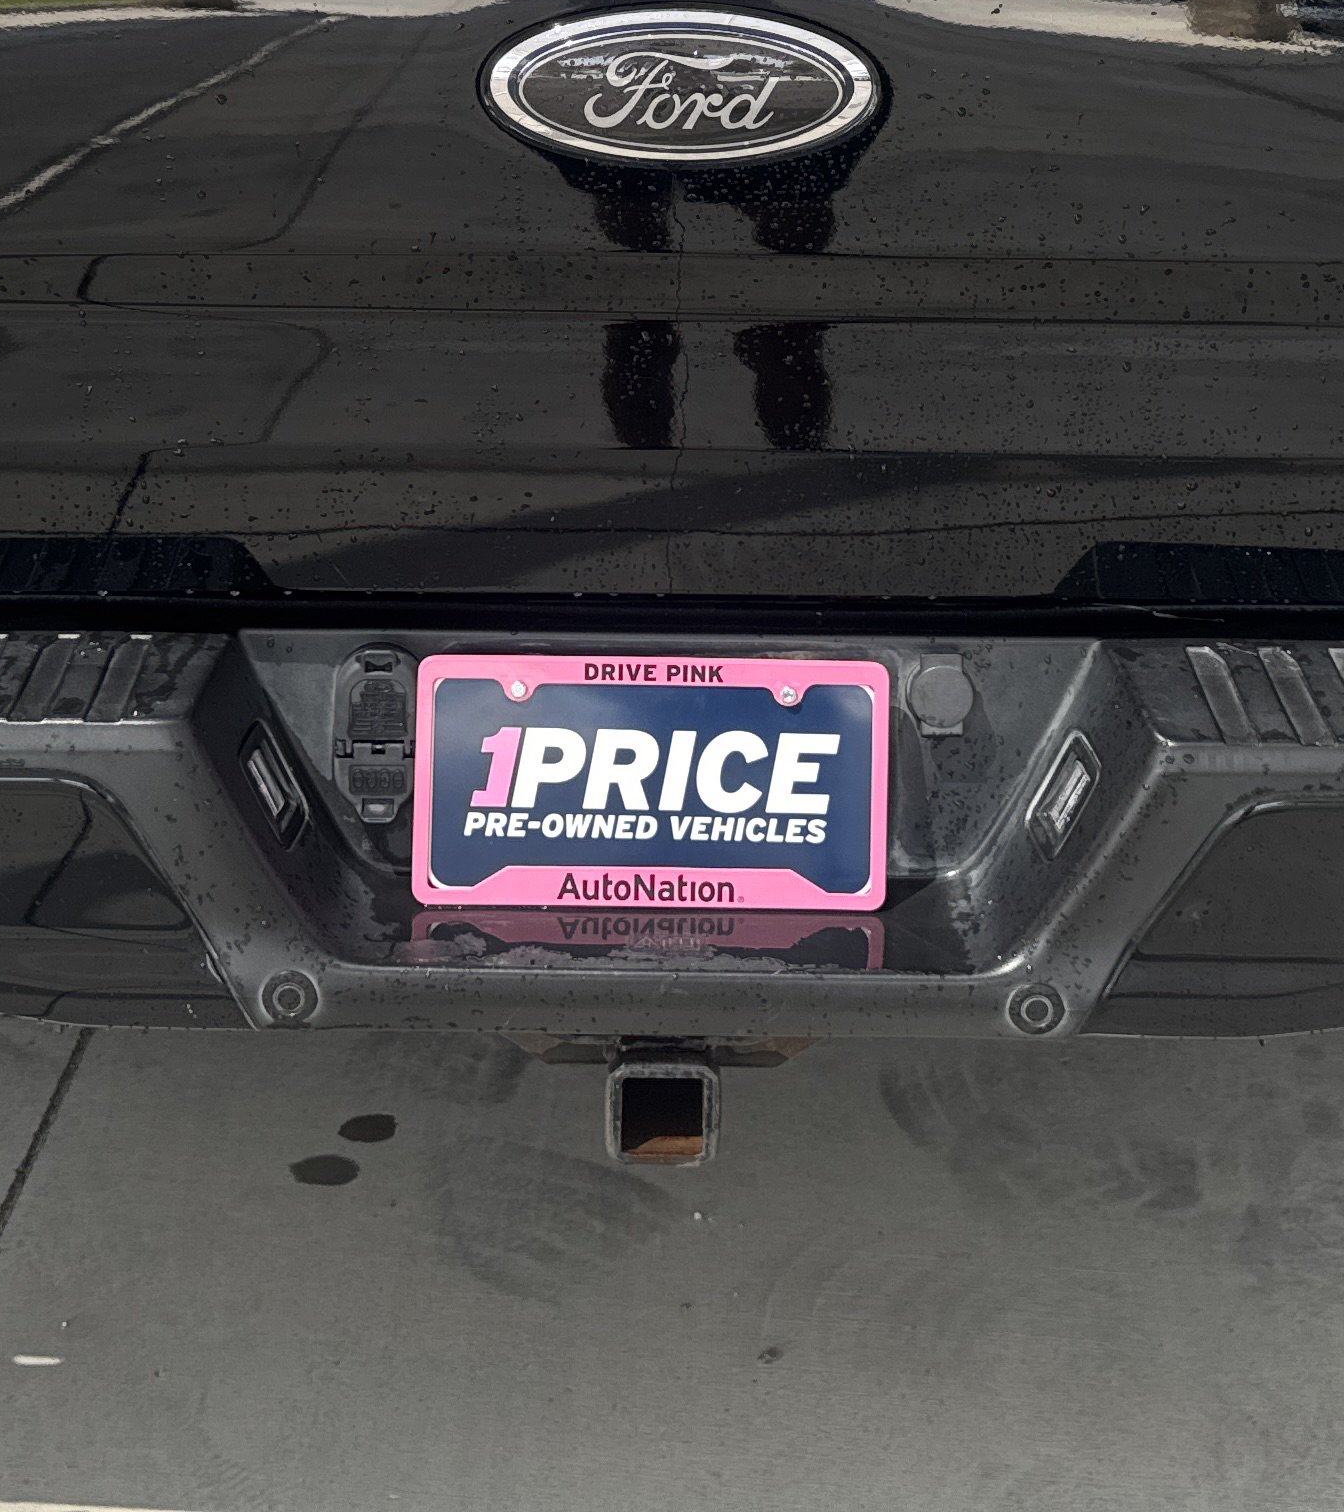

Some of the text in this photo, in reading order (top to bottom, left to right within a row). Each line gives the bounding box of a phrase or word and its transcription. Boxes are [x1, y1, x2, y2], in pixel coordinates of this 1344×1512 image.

[584, 51, 780, 130] Ford
[584, 662, 724, 684] DRIVE PINK
[463, 812, 827, 844] PRE-OWNED VEHICLES
[557, 873, 735, 902] AutoNation
